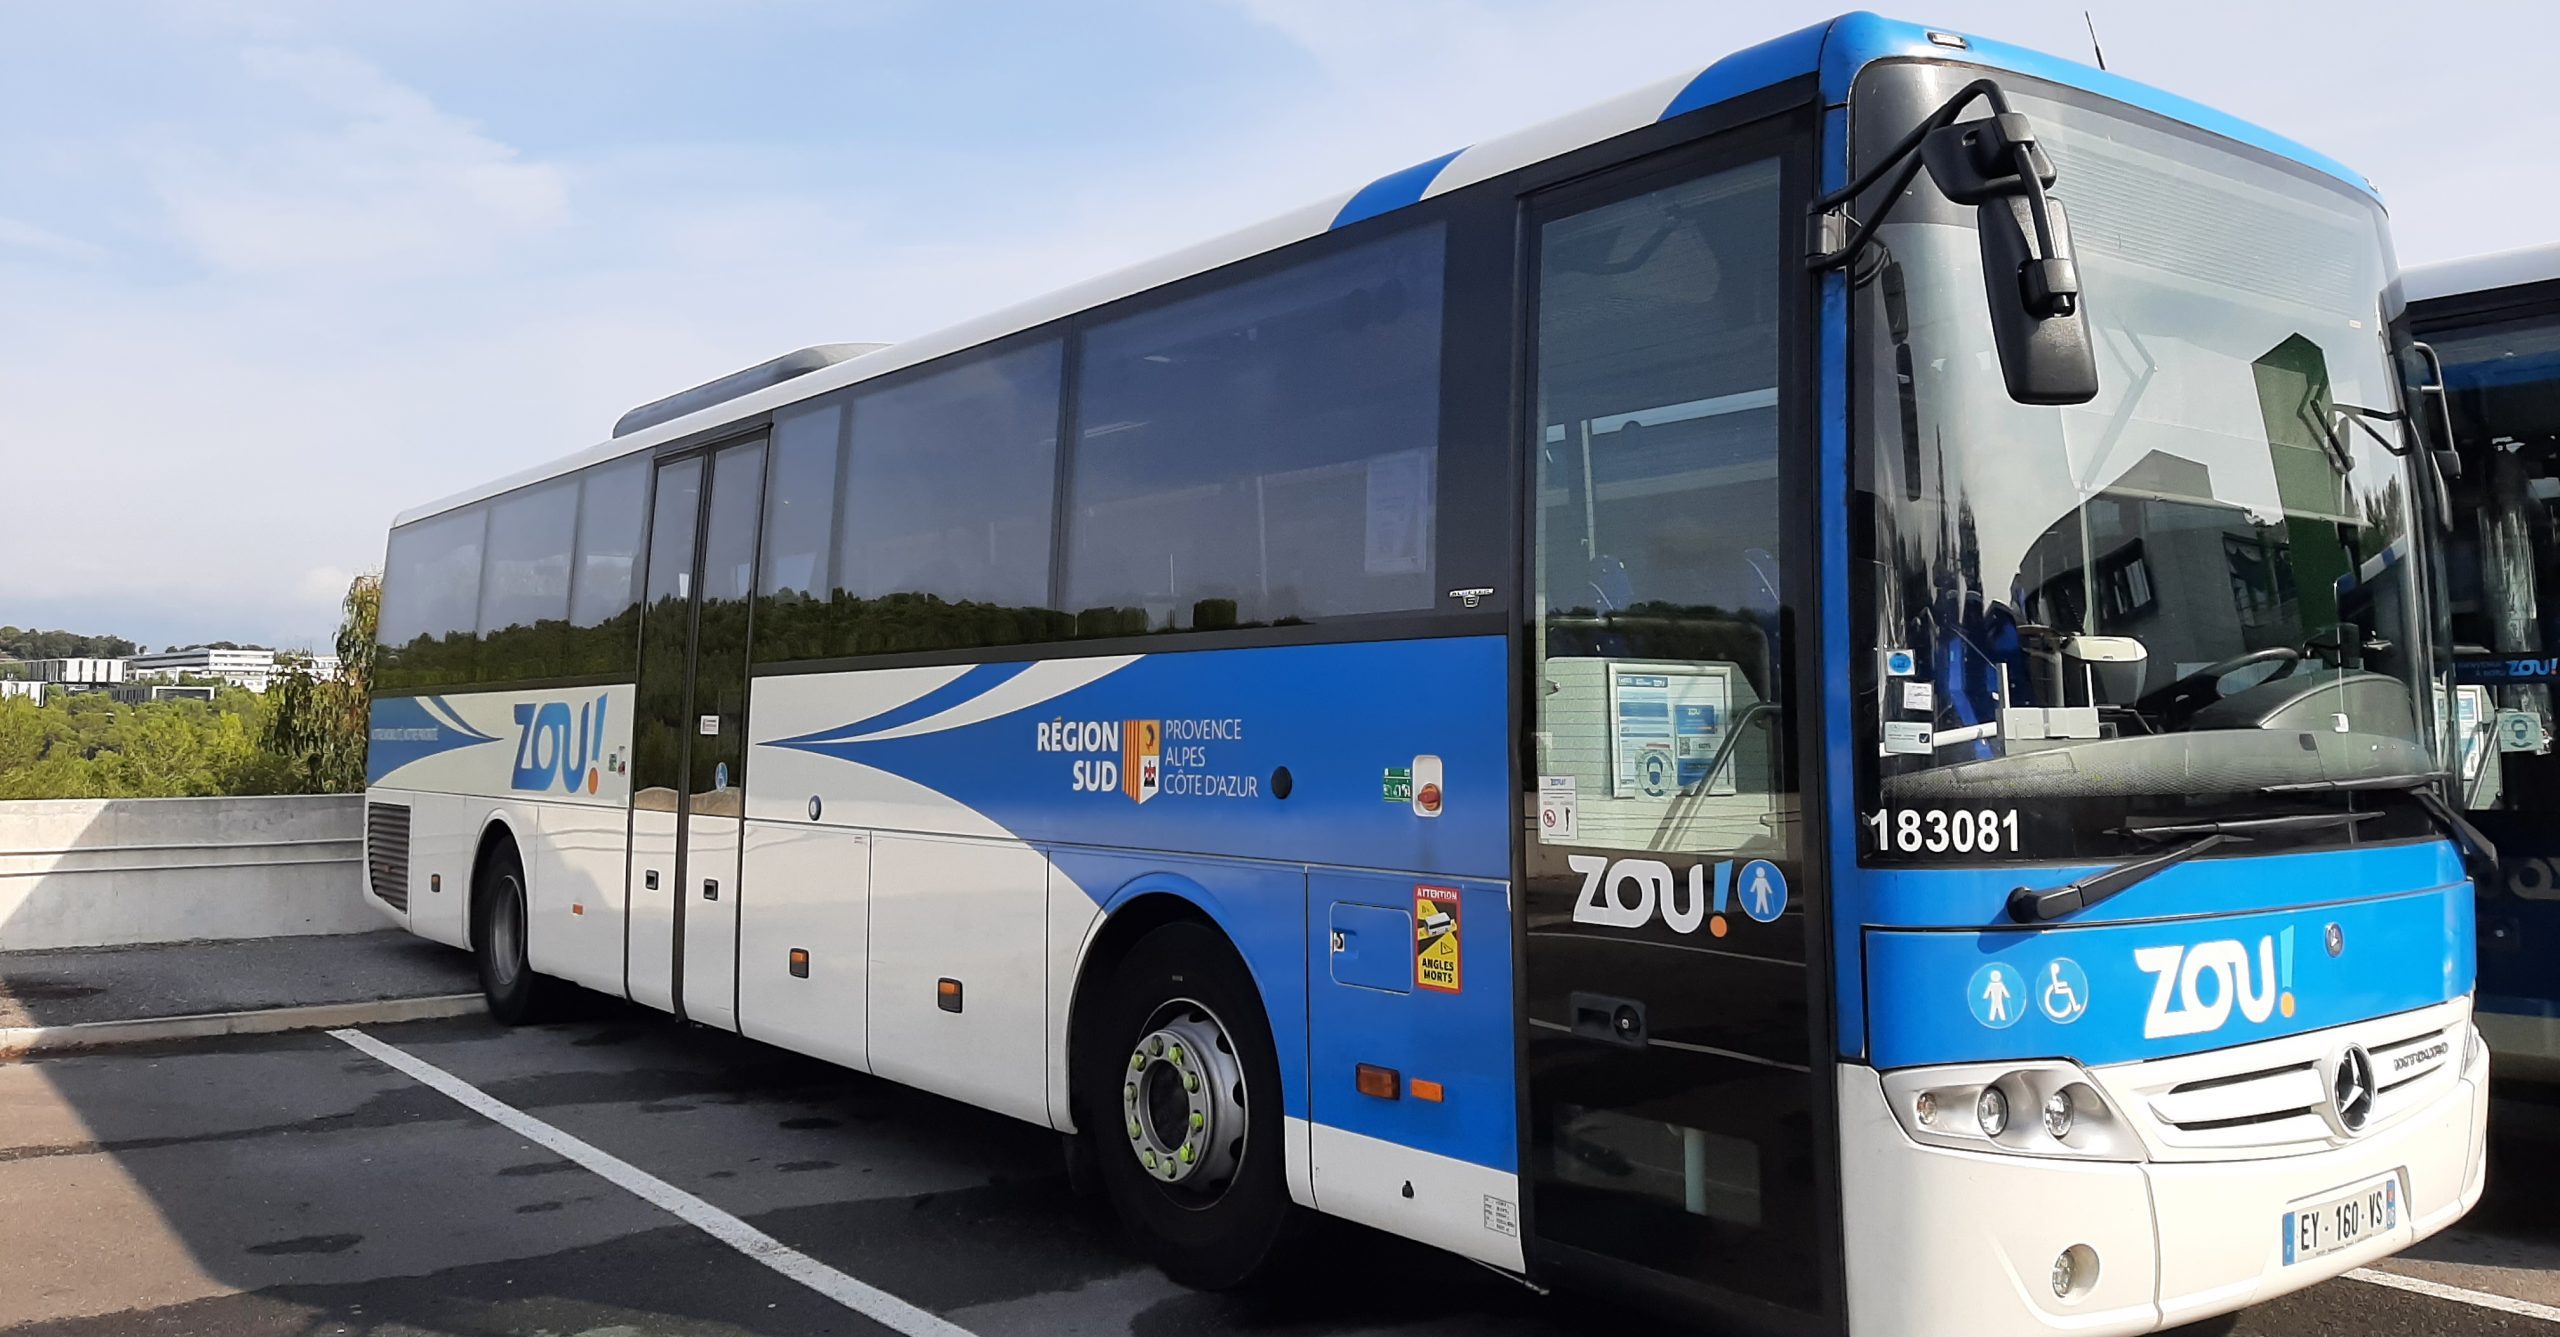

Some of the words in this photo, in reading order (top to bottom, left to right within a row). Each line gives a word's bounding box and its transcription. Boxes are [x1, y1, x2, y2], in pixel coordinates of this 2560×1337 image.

[2505, 658, 2558, 676] ZOU!
[1037, 717, 1119, 752] RÉGION
[1165, 719, 1242, 741] PROVENCE
[511, 692, 608, 795] ZOU!
[1165, 746, 1206, 767] ALPES
[1072, 760, 1118, 792] SUD
[1164, 773, 1202, 795] CÔTE
[1205, 775, 1259, 798] D'AZUR
[1871, 808, 2019, 853] 183081
[1416, 887, 1458, 900] ATTENTION
[1568, 855, 1733, 938] ZOU!
[1422, 957, 1454, 971] ANGLES
[1423, 969, 1453, 983] MORTS
[2135, 924, 2295, 1040] ZOU!
